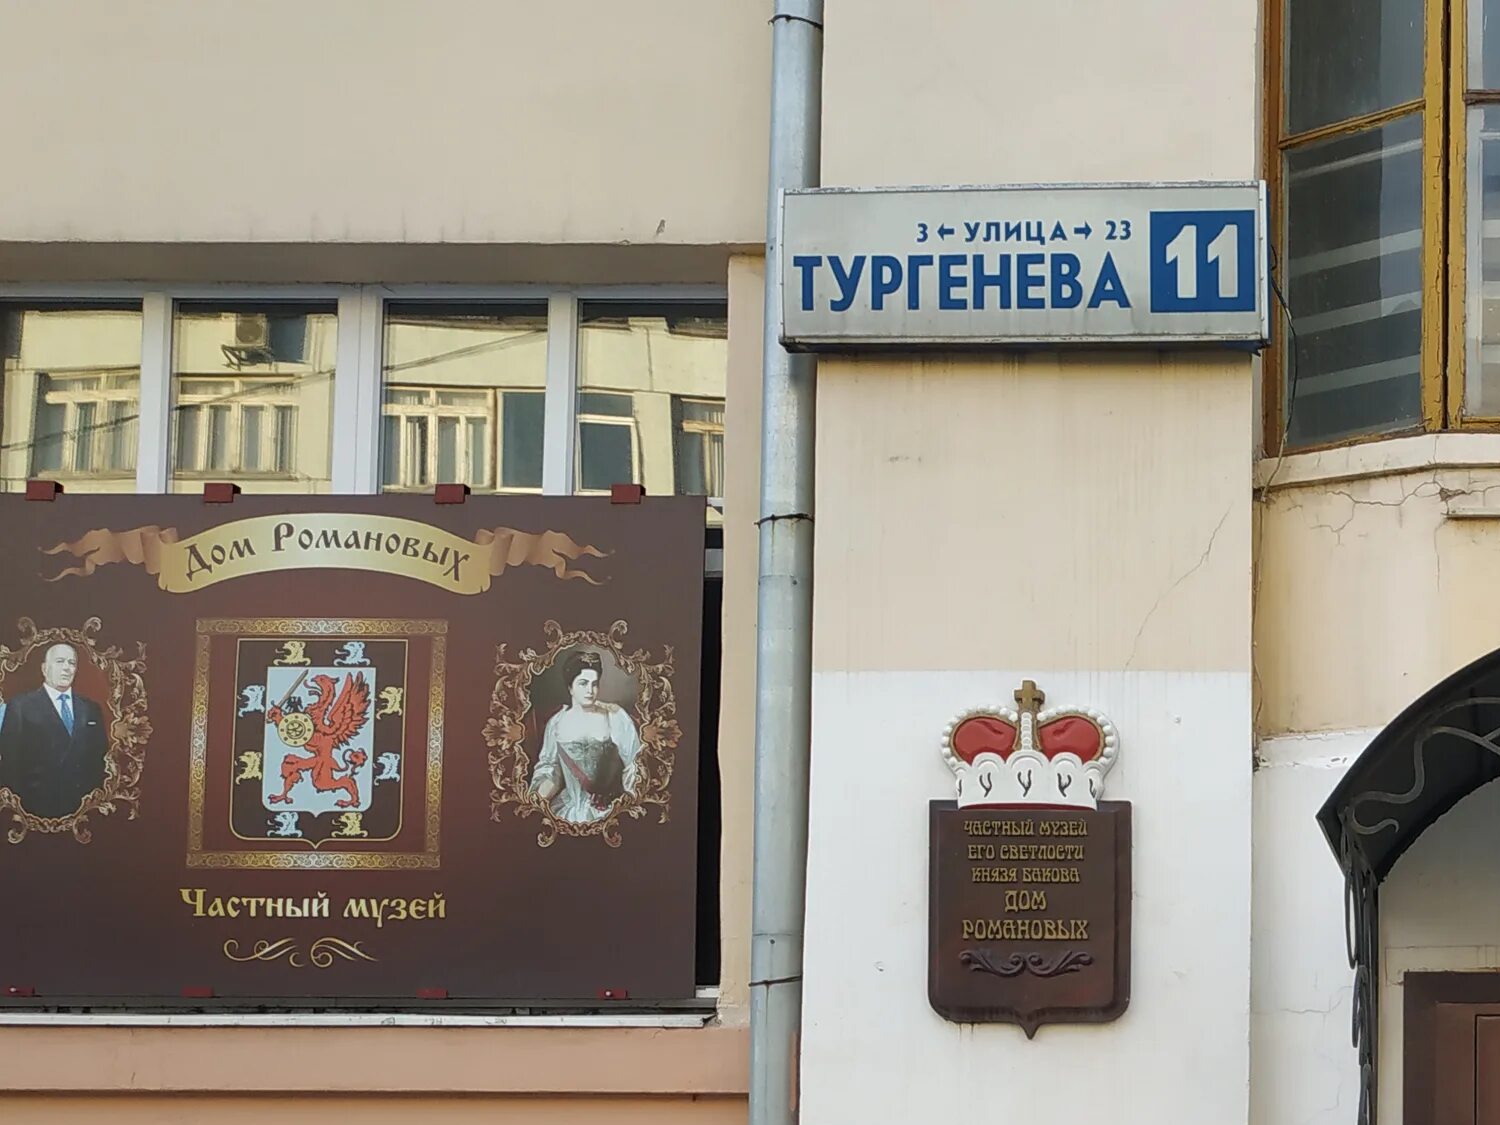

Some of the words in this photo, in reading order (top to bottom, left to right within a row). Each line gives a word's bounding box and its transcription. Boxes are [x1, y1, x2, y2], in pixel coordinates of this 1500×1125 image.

[916, 223, 928, 242] 3
[964, 221, 1067, 244] УЛИЦА
[1104, 220, 1132, 241] 23
[793, 251, 1132, 312] ТУРГЕНЕВА
[1165, 223, 1239, 299] 11
[184, 535, 255, 582] Дом
[271, 521, 473, 582] Романовых
[964, 818, 1034, 836] ЧАСТНЫЙ
[1039, 818, 1088, 836] МУЗЕЙ
[967, 844, 995, 860] ЕГО
[1000, 843, 1084, 860] СВЕТЛОСТИ
[971, 867, 1018, 883] КНЯЗЯ
[1022, 867, 1080, 883] БАКОВА
[180, 887, 330, 920] Частный
[343, 890, 447, 927] музей
[1004, 890, 1047, 913] ДОМ
[962, 919, 1089, 940] РОМАНОВЫХ
